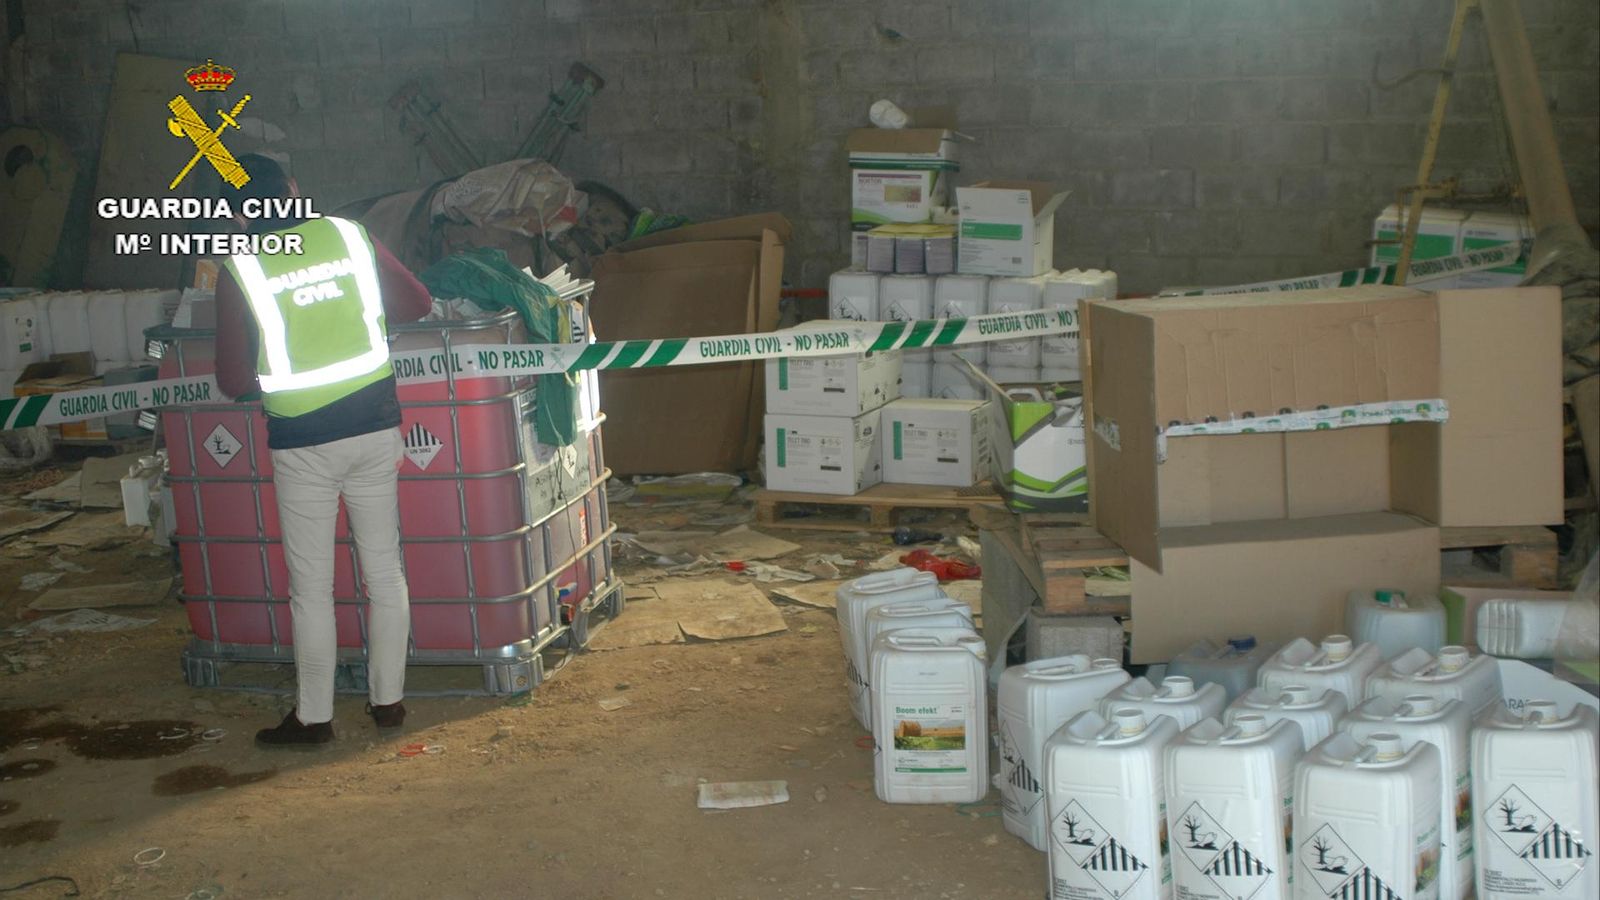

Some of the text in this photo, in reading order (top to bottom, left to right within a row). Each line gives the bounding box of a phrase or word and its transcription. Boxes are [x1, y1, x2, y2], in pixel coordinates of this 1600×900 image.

[293, 280, 344, 306] CIVIL
[978, 315, 1022, 335] GUARDIA
[1024, 312, 1048, 330] CIVIL
[1057, 310, 1073, 327] NO
[700, 338, 751, 358] GUARDIA
[755, 336, 782, 354] CIVIL
[793, 335, 812, 351] NO
[814, 332, 850, 350] PASAR
[478, 351, 499, 370] NO
[503, 349, 544, 369] PASAR
[59, 397, 108, 417] GUARDIA
[112, 390, 140, 409] CIVIL
[152, 386, 169, 406] NO
[174, 382, 211, 403] PASAR
[896, 706, 916, 714] Boom
